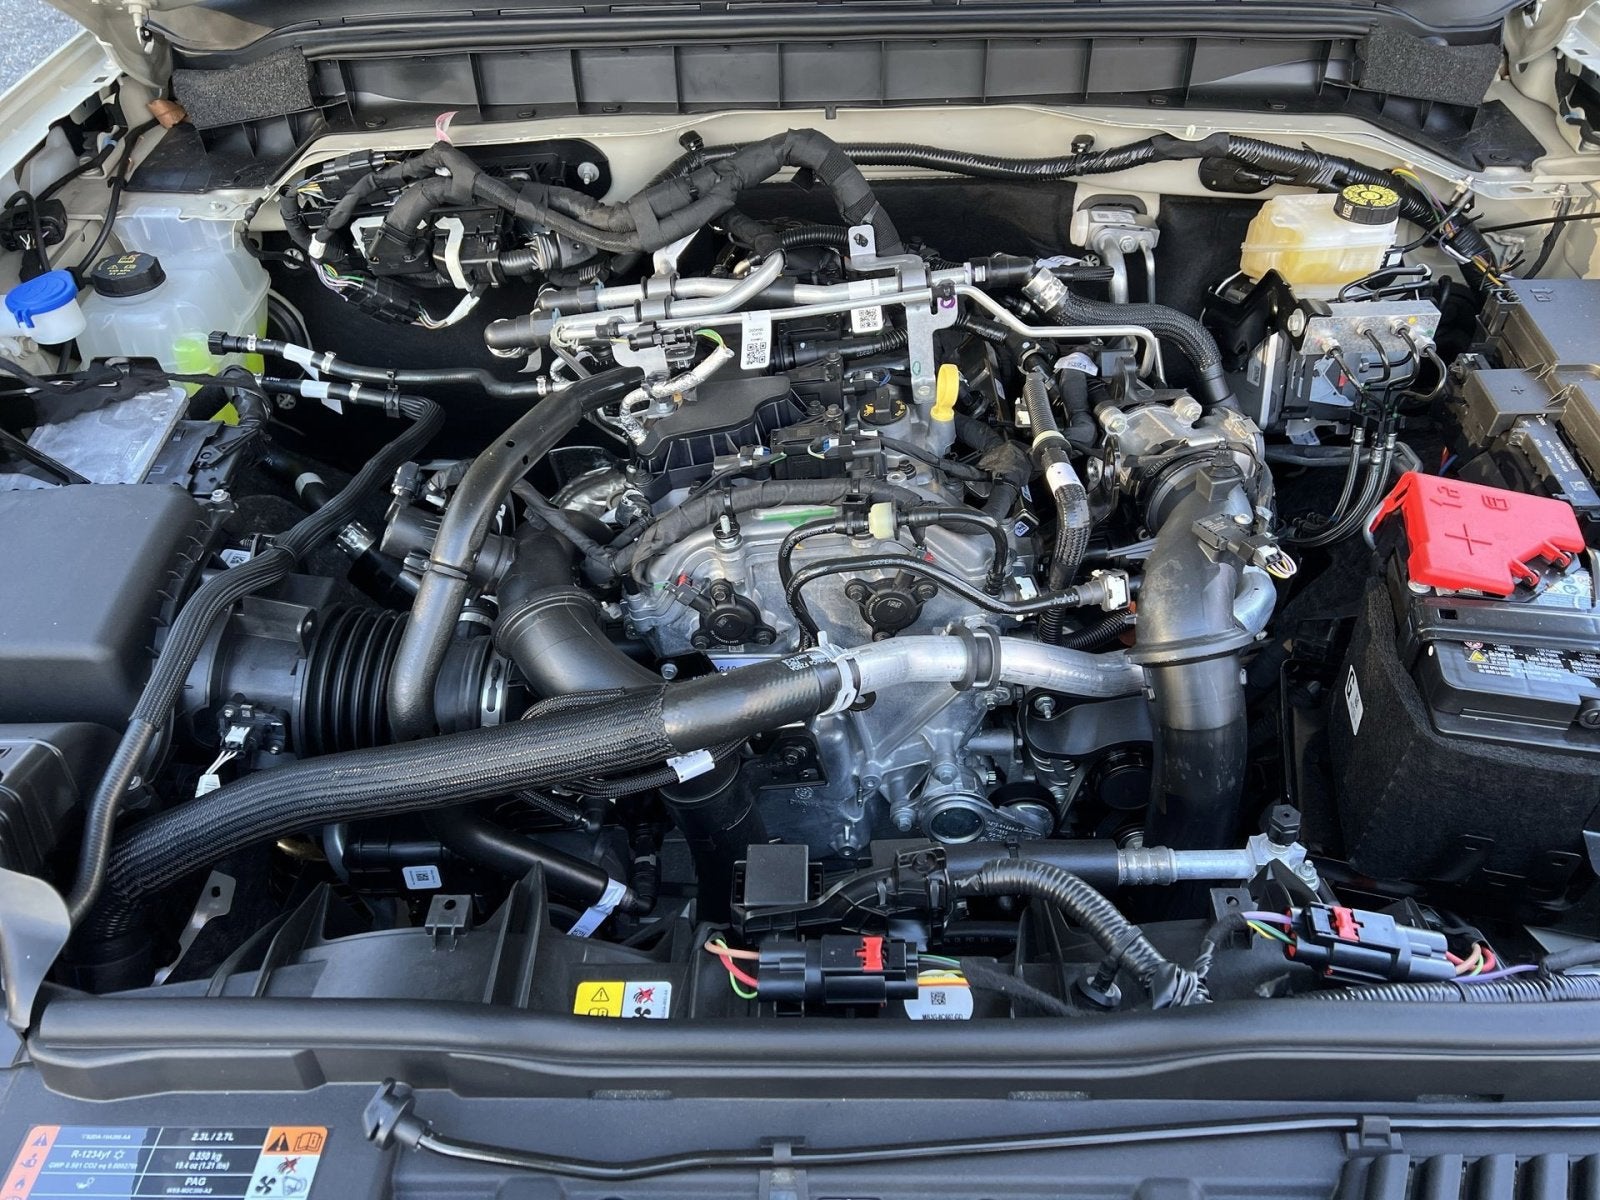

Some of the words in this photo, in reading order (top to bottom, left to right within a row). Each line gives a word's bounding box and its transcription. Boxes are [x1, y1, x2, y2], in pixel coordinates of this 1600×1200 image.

[191, 1132, 211, 1141] 2.3L
[215, 1132, 234, 1141] 2.7L
[71, 1149, 111, 1161] R-1234yf
[210, 1151, 223, 1162] kg
[184, 1177, 207, 1186] PAG
